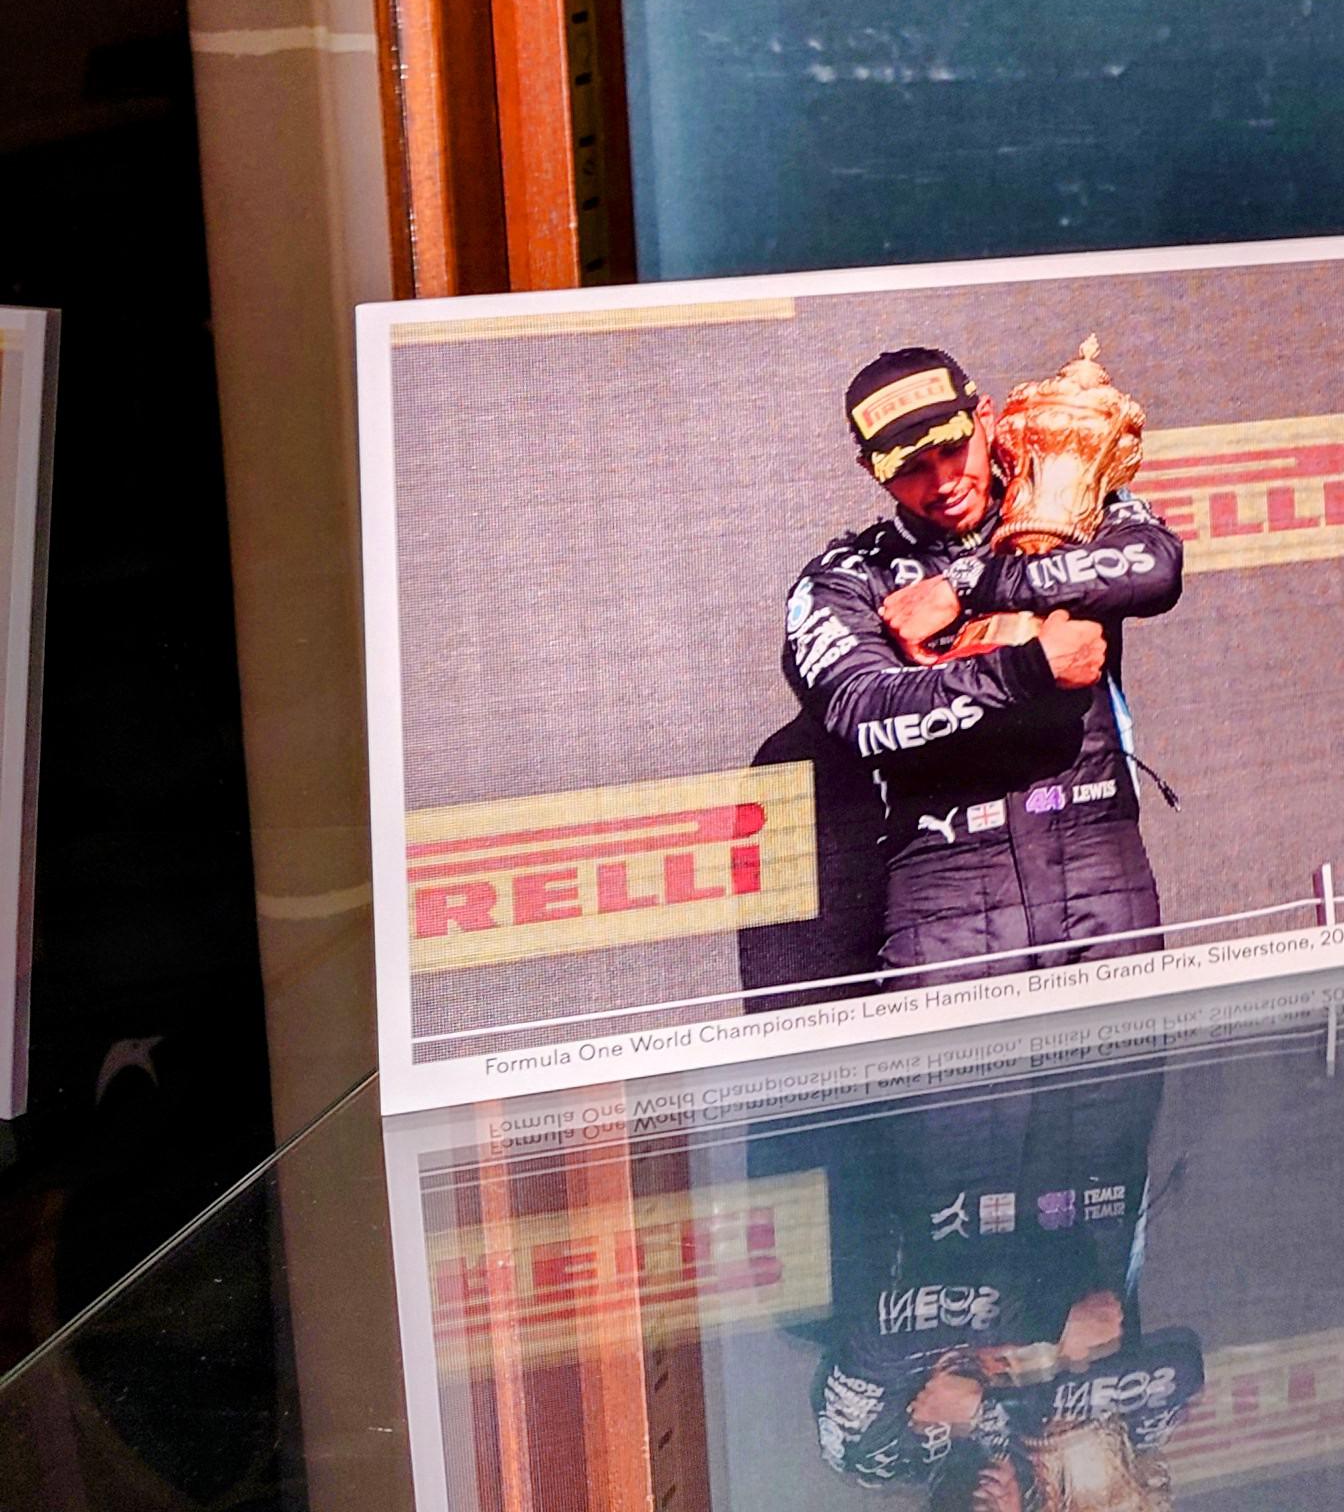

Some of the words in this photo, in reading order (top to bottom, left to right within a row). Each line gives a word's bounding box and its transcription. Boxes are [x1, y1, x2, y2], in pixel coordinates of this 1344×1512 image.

[1027, 543, 1157, 589] INEOS
[857, 694, 985, 757] INEOS
[1072, 779, 1117, 804] LEWIS
[484, 1048, 571, 1076] Formula
[577, 1043, 623, 1062] One
[628, 1029, 692, 1053] World
[698, 1007, 855, 1043] Championship:
[861, 996, 919, 1018] Lewis
[924, 983, 1020, 1009] Hamilton,
[1027, 968, 1089, 993] British
[1095, 957, 1155, 981] Grand
[1160, 953, 1201, 971] Prix,
[1207, 938, 1314, 964] Silverstone,
